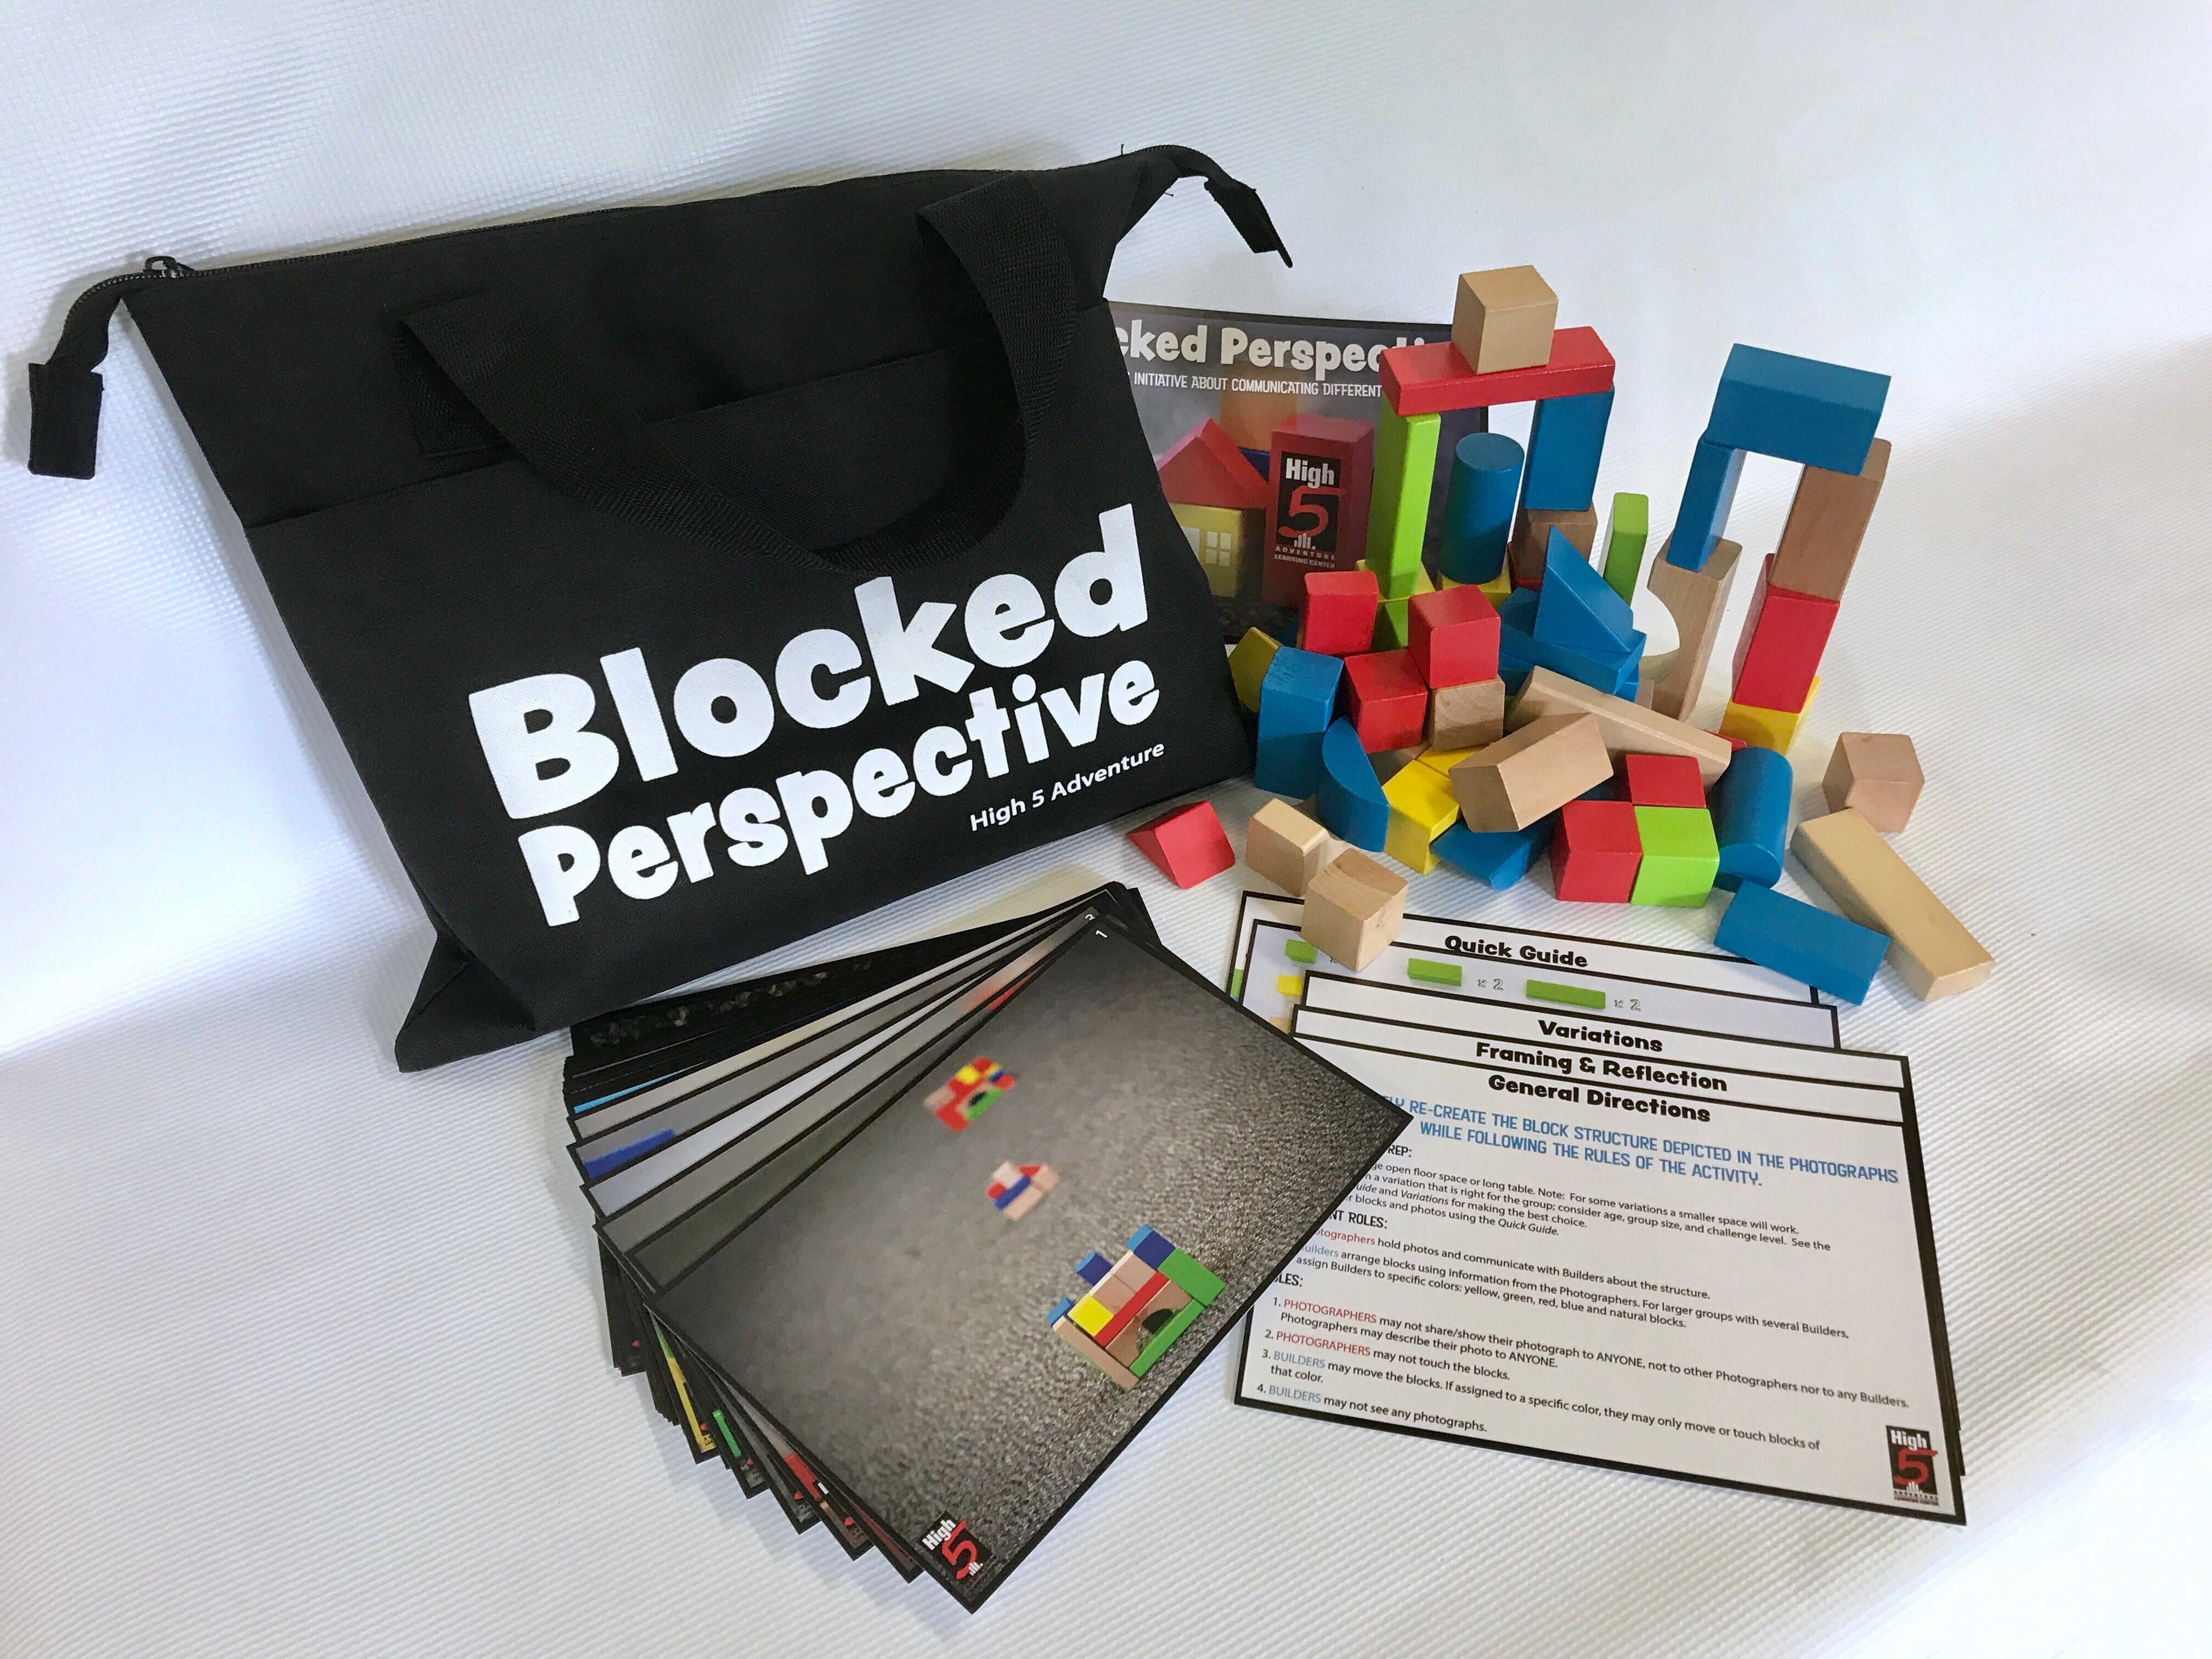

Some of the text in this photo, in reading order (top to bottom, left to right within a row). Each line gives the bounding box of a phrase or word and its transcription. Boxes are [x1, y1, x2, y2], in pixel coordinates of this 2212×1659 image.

[1134, 372, 1382, 398] INITIATIVE ABOUT COMMUNICATING DIFFERENT
[1285, 458, 1335, 489] High
[1278, 486, 1347, 538] 5
[469, 503, 1148, 820] Blocked
[517, 659, 1160, 927] Perspective
[970, 743, 1164, 832] High 5 Adventure
[1444, 935, 1588, 968] Quick Guide
[1493, 978, 1504, 991] 2
[1629, 998, 1641, 1012] 2
[1538, 1019, 1663, 1053] Variations
[1476, 1042, 1728, 1093] Framing & Reflection
[1488, 1074, 1711, 1123] General Directions
[1387, 1144, 1413, 1158] REP:
[1409, 1099, 1487, 1125] RE-CREATE
[1491, 1113, 1518, 1130] THE
[1522, 1118, 1569, 1138] BLOCK
[1573, 1126, 1658, 1152] STRUCTURE
[1662, 1139, 1732, 1162] DEPICTED
[1736, 1149, 1752, 1165] IN
[1756, 1152, 1785, 1170] THE
[1788, 1156, 1899, 1184] PHOTOGRAPHS
[1420, 1120, 1763, 1187] WHILE FOLLOWING THE RULES OF THE ACTIVITY.
[1347, 1211, 1388, 1229] ROLES:
[1355, 1193, 1387, 1208] blocks
[1389, 1201, 1409, 1212] and
[1410, 1203, 1447, 1218] photos
[1448, 1211, 1477, 1224] using
[1478, 1215, 1496, 1226] the
[1498, 1218, 1527, 1231] Quick
[1527, 1222, 1559, 1236] Guide.
[1385, 1164, 1411, 1175] open
[1413, 1167, 1437, 1180] floor
[1438, 1173, 1468, 1184] space
[1482, 1178, 1505, 1192] long
[1507, 1183, 1536, 1195] table.
[1538, 1187, 1565, 1200] Note:
[1570, 1192, 1587, 1203] For
[1588, 1197, 1617, 1208] some
[1617, 1201, 1668, 1216] variations
[1678, 1211, 1716, 1223] smaller
[1717, 1217, 1748, 1228] space
[1749, 1221, 1768, 1231] will
[1769, 1224, 1799, 1235] work.
[1296, 1256, 1686, 1328] assign Builders to specific colors: yellow, green, red, blue and natural blocks.
[1305, 1244, 1849, 1339] uilders arrange blocks using information from the Photographers. For larger groups with several Builders,
[1264, 1328, 1510, 1381] 2. PHOTOGRAPHERS may not touch the blocks.
[1273, 1296, 1910, 1408] 1. PHOTOGRAPHERS may not share/show their photograph to ANYONE, not to other Photographers nor to any Builders.
[1256, 1383, 1487, 1432] 4. BUILDERS may not see any photographs.
[1261, 1348, 1821, 1451] 3. BUILDERS may move the blocks. If assigned to a specific color, they may only move or touch blocks of
[1890, 1429, 1927, 1451] High
[1893, 1447, 1938, 1486] 5
[922, 1518, 957, 1551] High
[941, 1520, 978, 1579] 5
